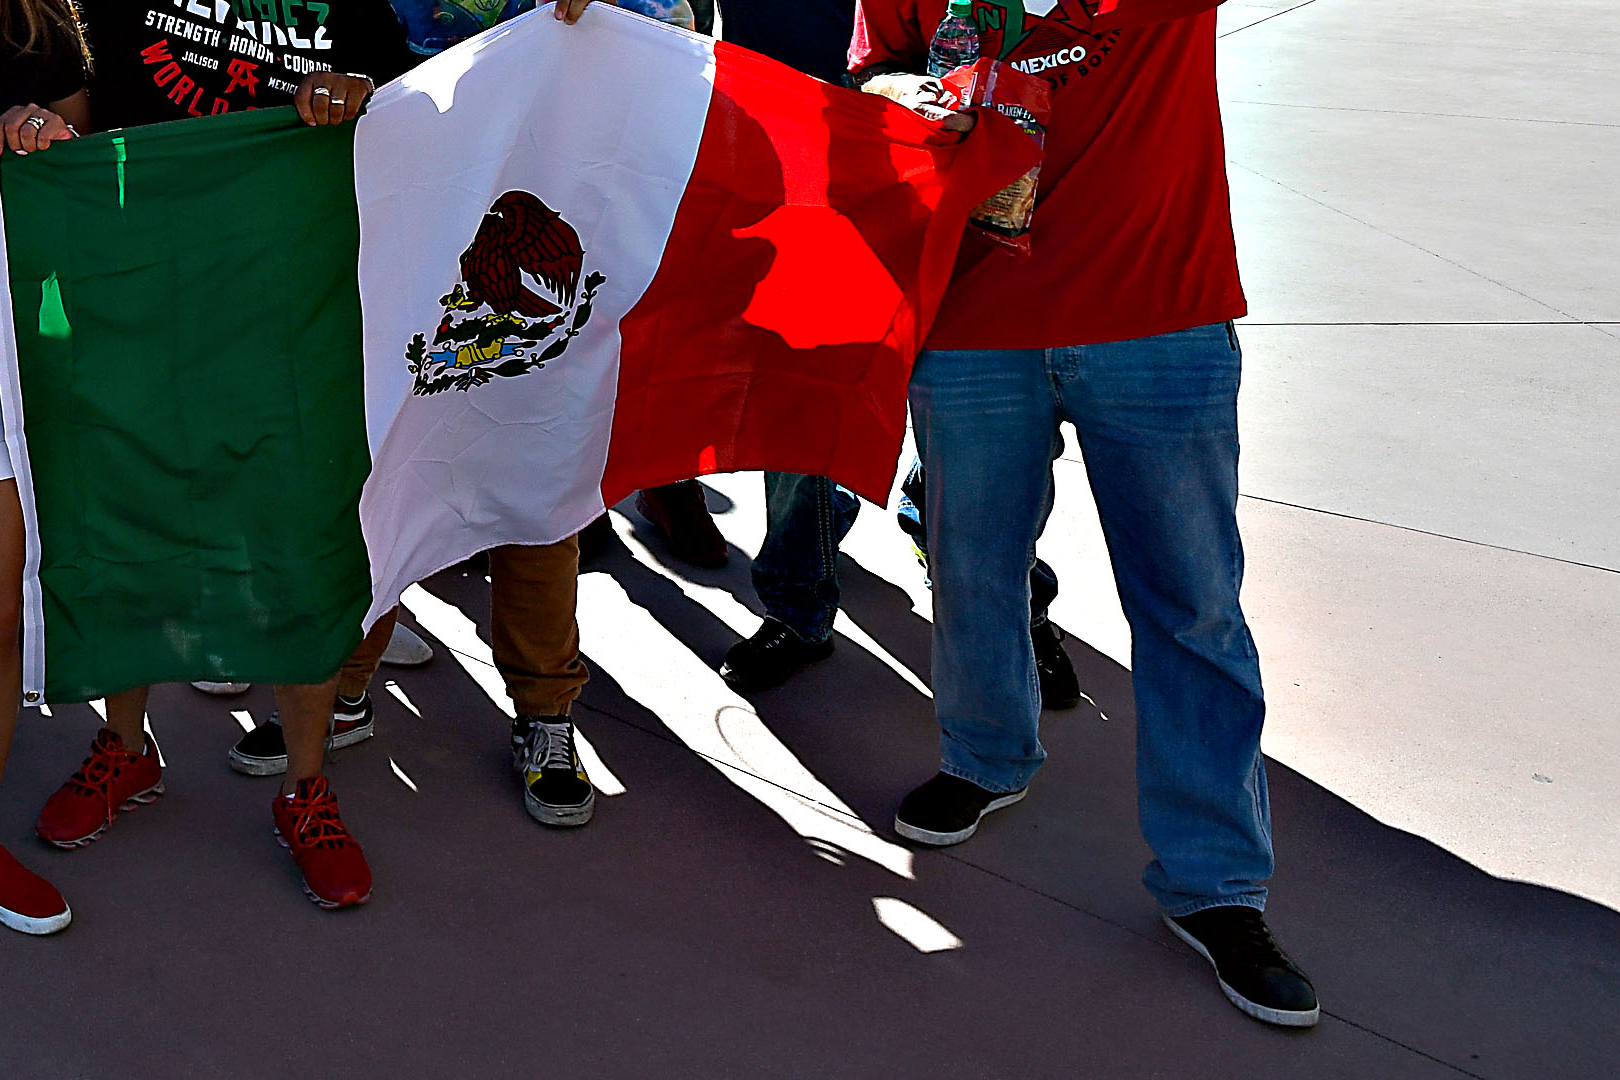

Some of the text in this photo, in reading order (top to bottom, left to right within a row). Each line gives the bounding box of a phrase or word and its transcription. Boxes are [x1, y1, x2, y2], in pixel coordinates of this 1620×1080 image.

[145, 9, 222, 48] STRENGTH
[140, 38, 230, 118] WORLD
[182, 50, 219, 71] JALISCO
